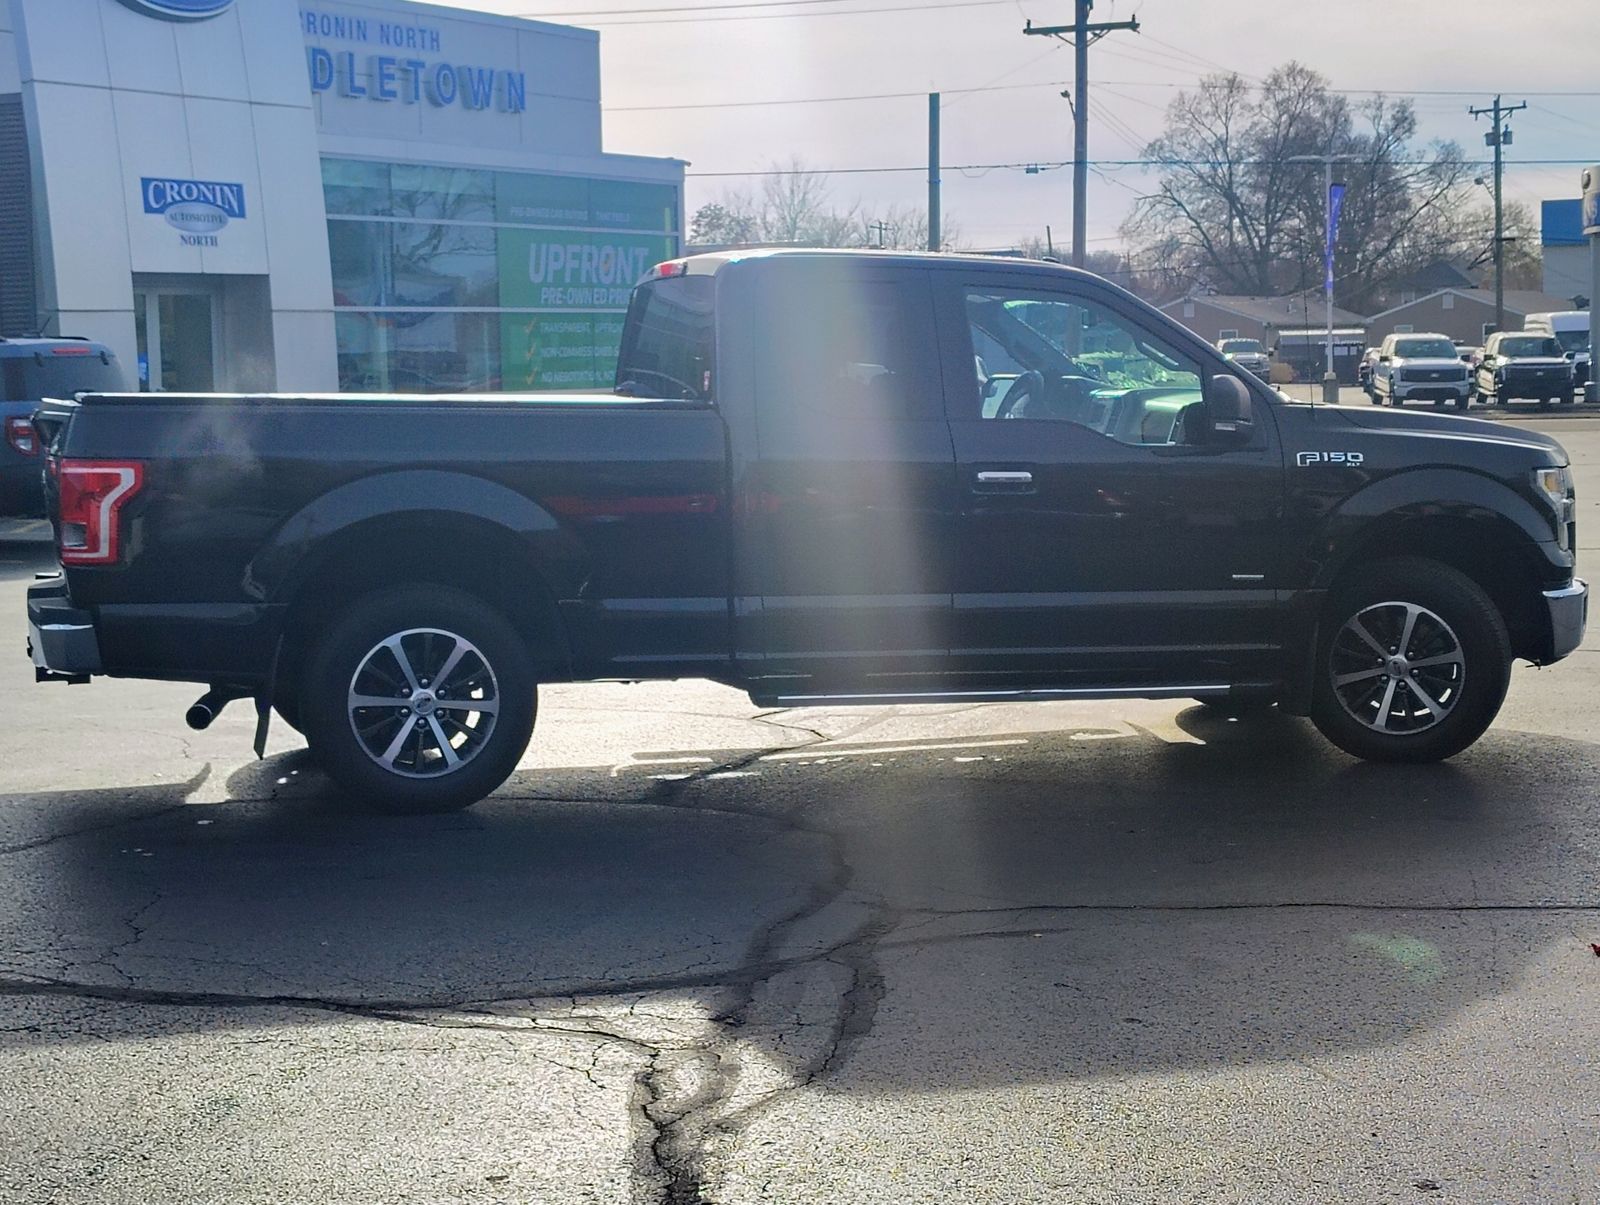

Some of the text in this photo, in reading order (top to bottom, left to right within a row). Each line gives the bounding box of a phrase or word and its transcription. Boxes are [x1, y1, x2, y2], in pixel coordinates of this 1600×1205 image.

[299, 11, 441, 51] RONIN NORTH
[148, 180, 239, 215] CRONIN
[169, 212, 223, 224] AUTOMOTIVE
[180, 234, 218, 247] NORTH
[529, 243, 649, 284] UPFRONT
[540, 286, 607, 305] PRE-OWNED
